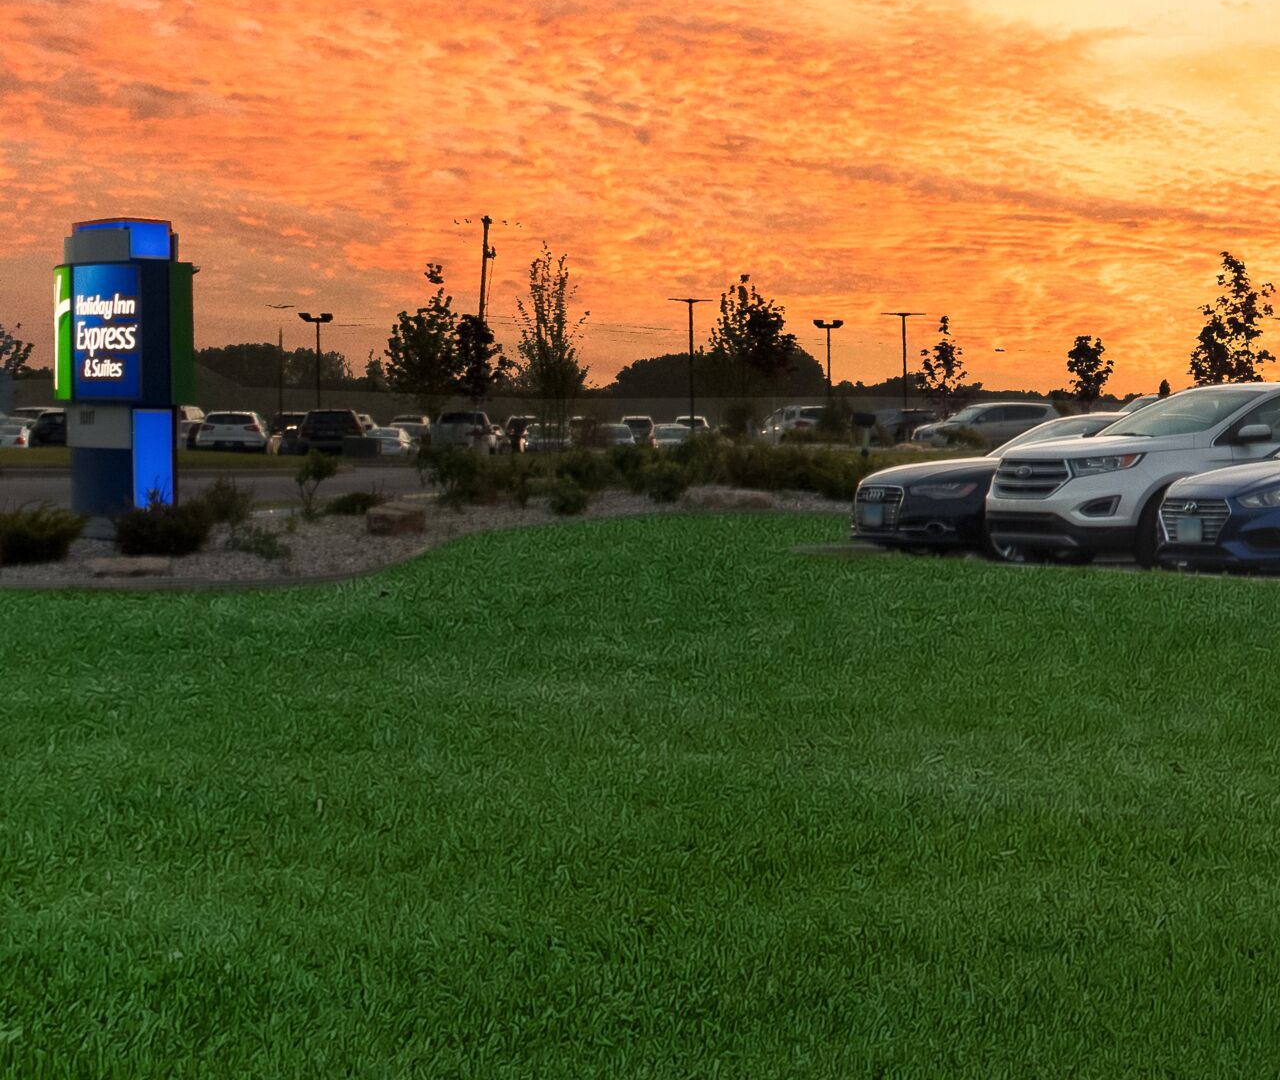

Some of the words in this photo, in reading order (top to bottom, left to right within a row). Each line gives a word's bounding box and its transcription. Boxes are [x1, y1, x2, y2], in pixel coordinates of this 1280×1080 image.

[76, 294, 113, 320] Holiday
[113, 293, 136, 314] Inn
[76, 321, 136, 358] Express
[84, 359, 92, 377] &
[92, 358, 123, 377] Suites
